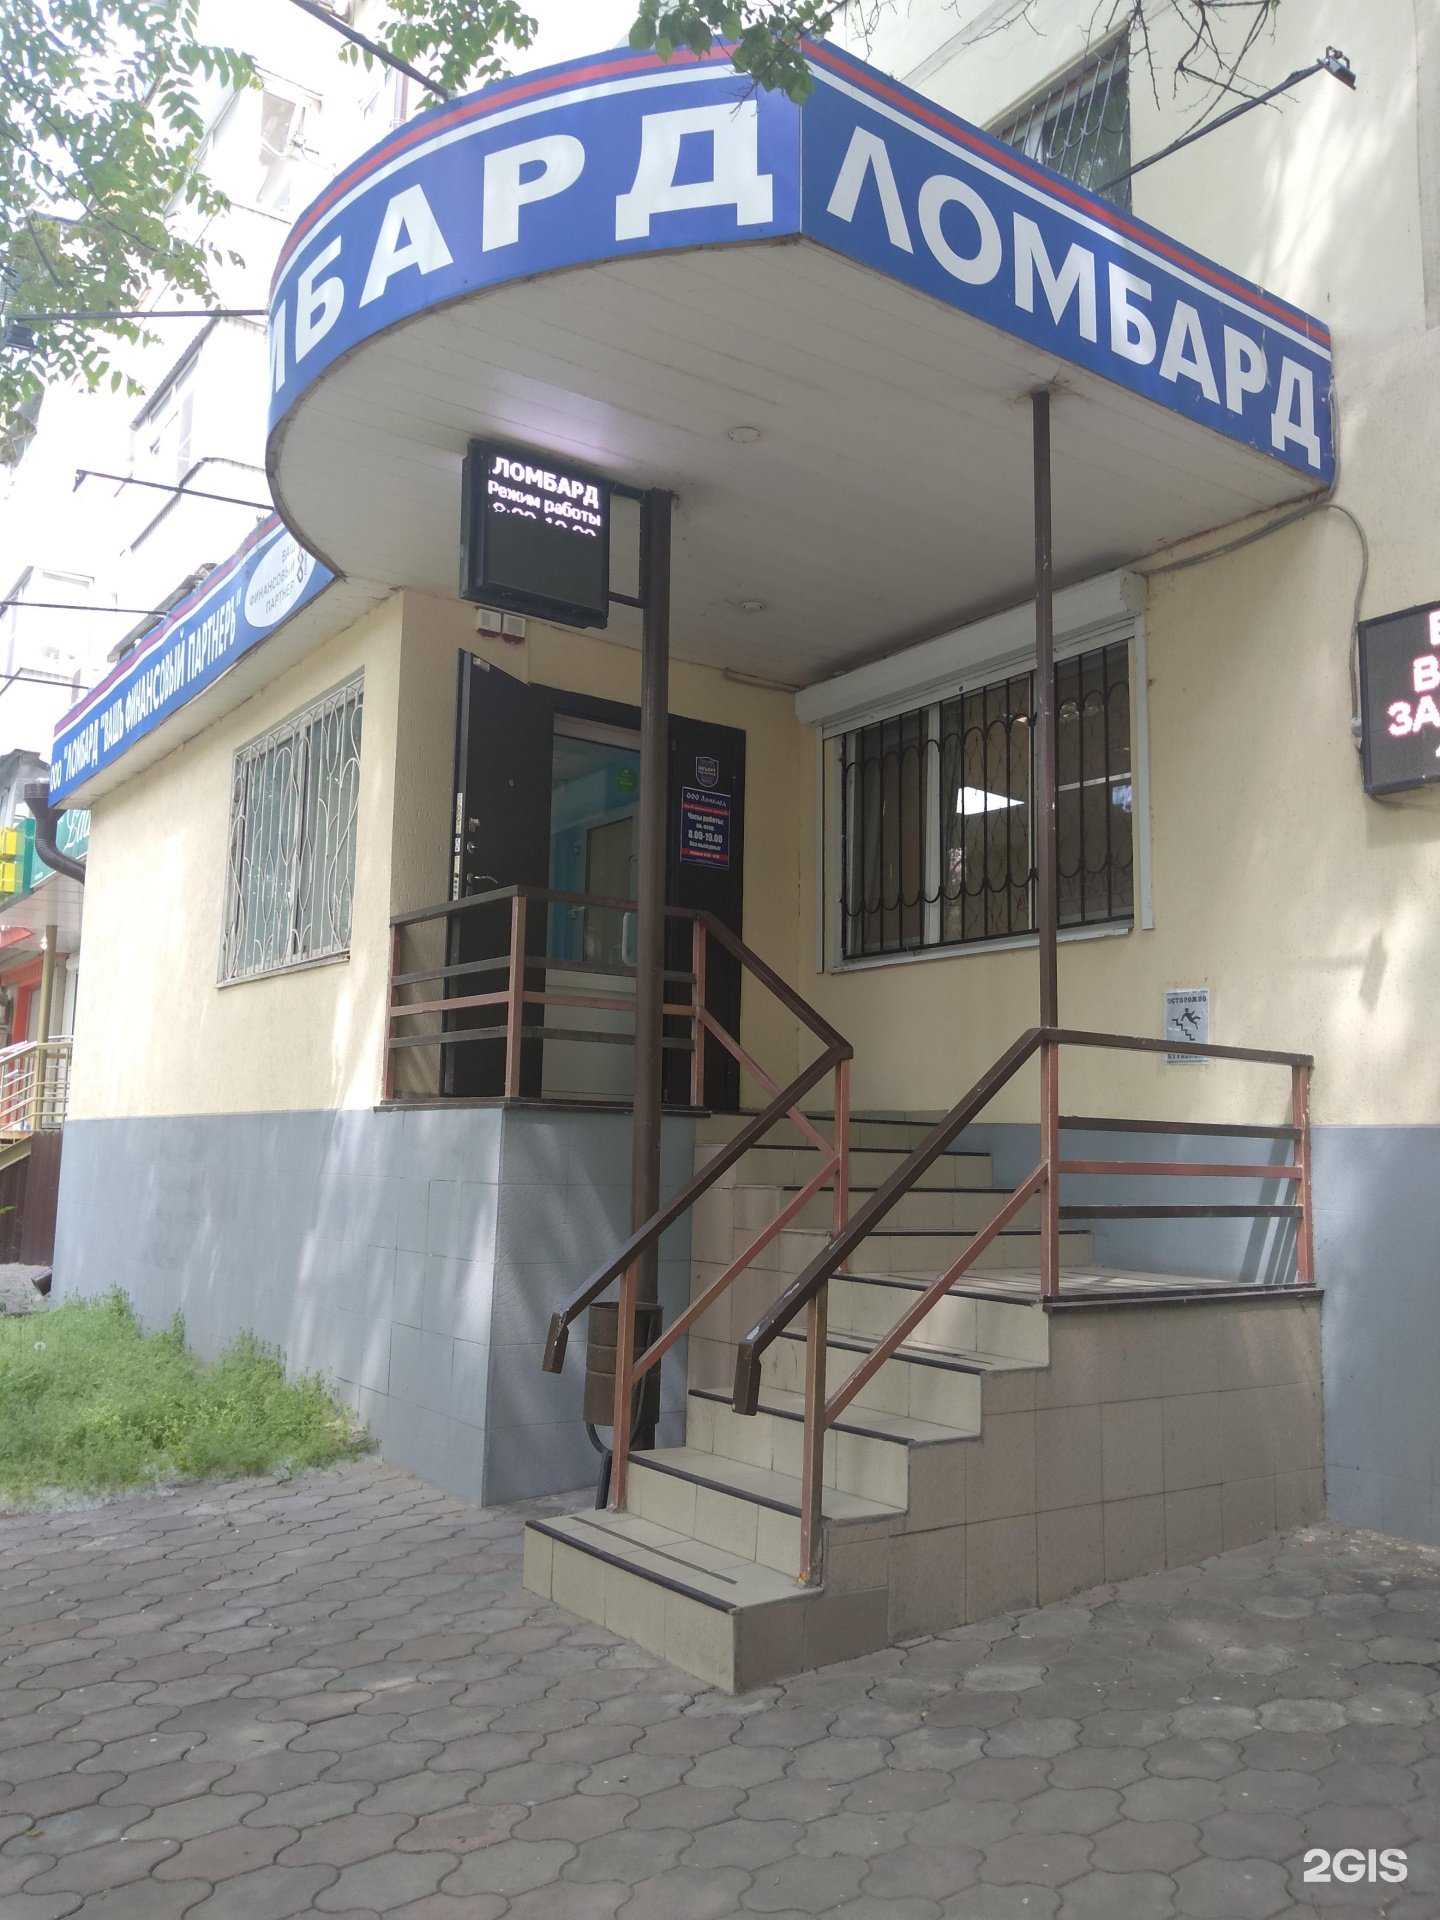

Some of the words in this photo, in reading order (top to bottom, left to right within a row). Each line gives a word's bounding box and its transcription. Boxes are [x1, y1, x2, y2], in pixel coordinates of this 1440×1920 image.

[827, 126, 1321, 470] ЛОМБАРД
[487, 480, 541, 509] Режим
[543, 499, 601, 527] работы
[491, 456, 599, 509] ЛОМБАРД
[125, 627, 185, 734] ФИНАНСОВЫЙ
